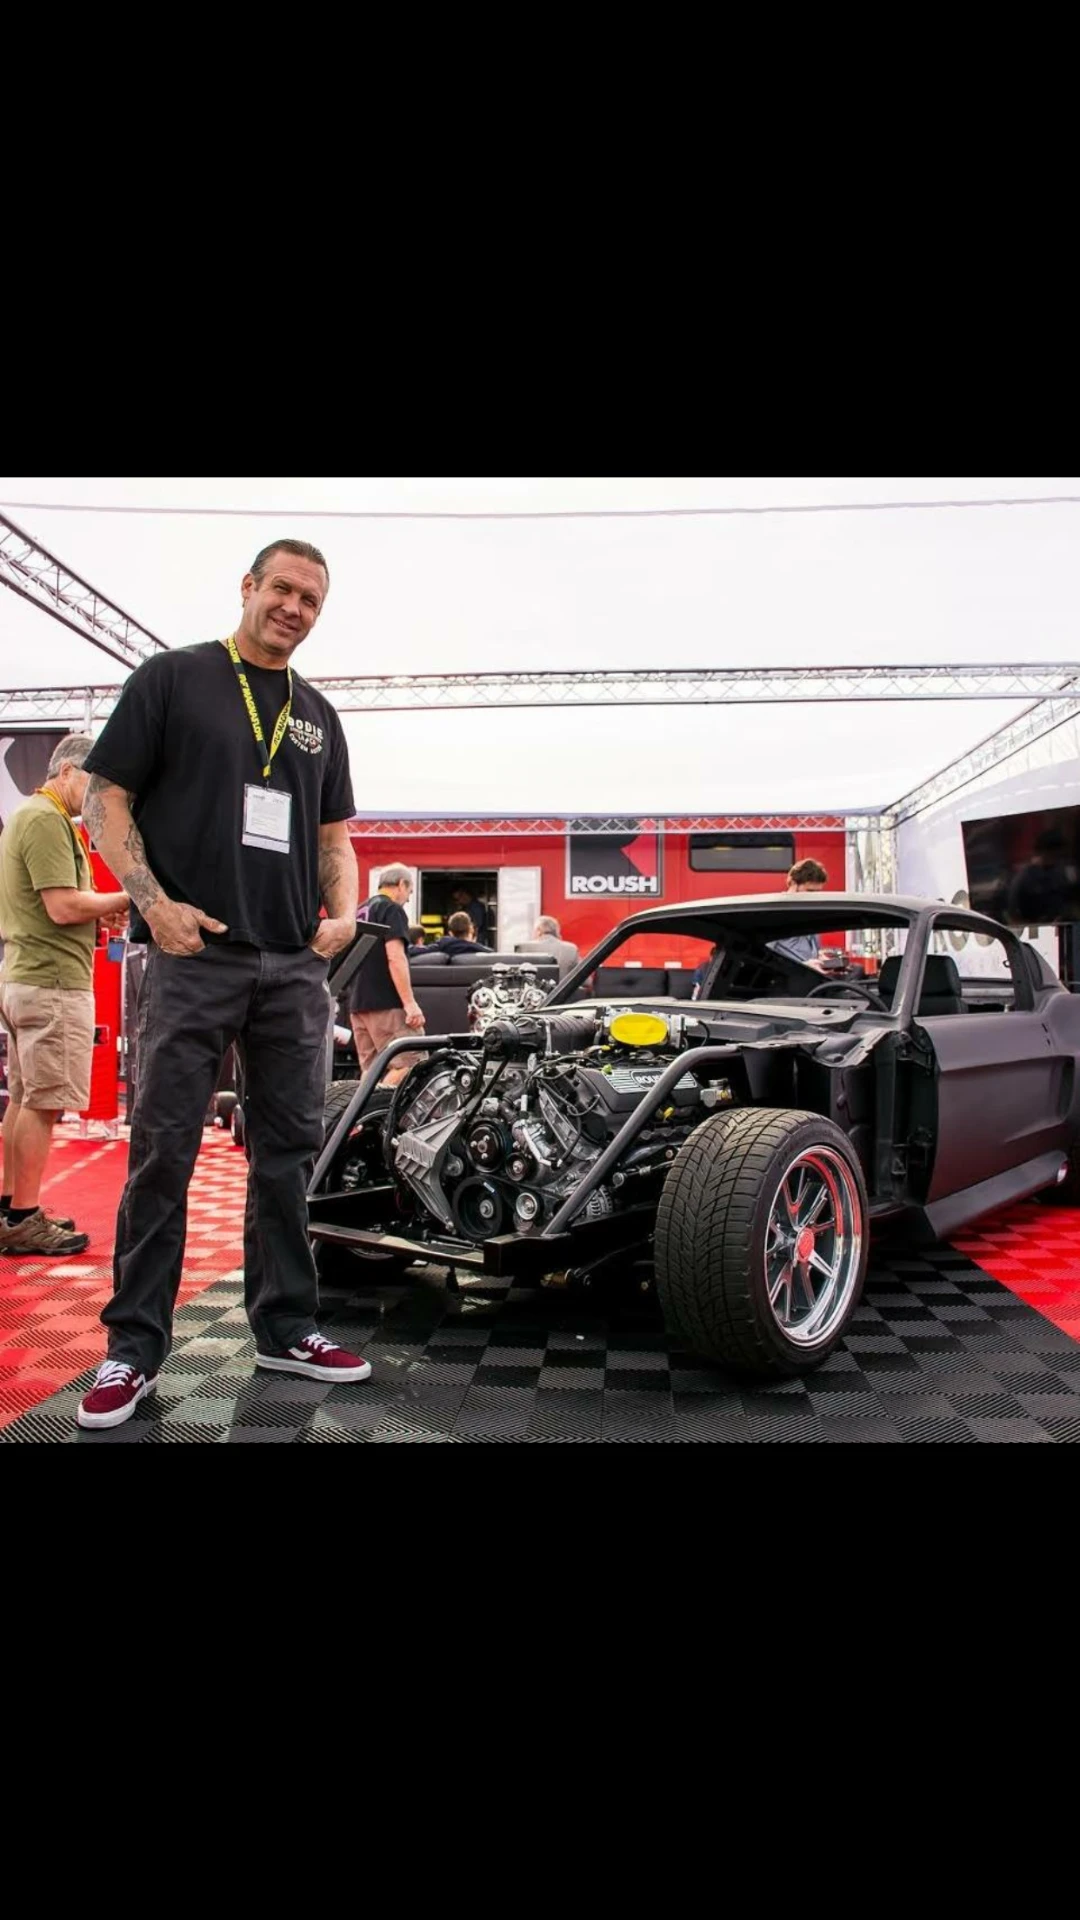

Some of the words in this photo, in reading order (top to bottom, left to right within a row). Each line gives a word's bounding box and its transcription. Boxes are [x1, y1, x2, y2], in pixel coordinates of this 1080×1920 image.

[242, 687, 264, 742] MAGNAFLOW
[287, 716, 324, 740] BODIE
[572, 875, 657, 892] ROUSH
